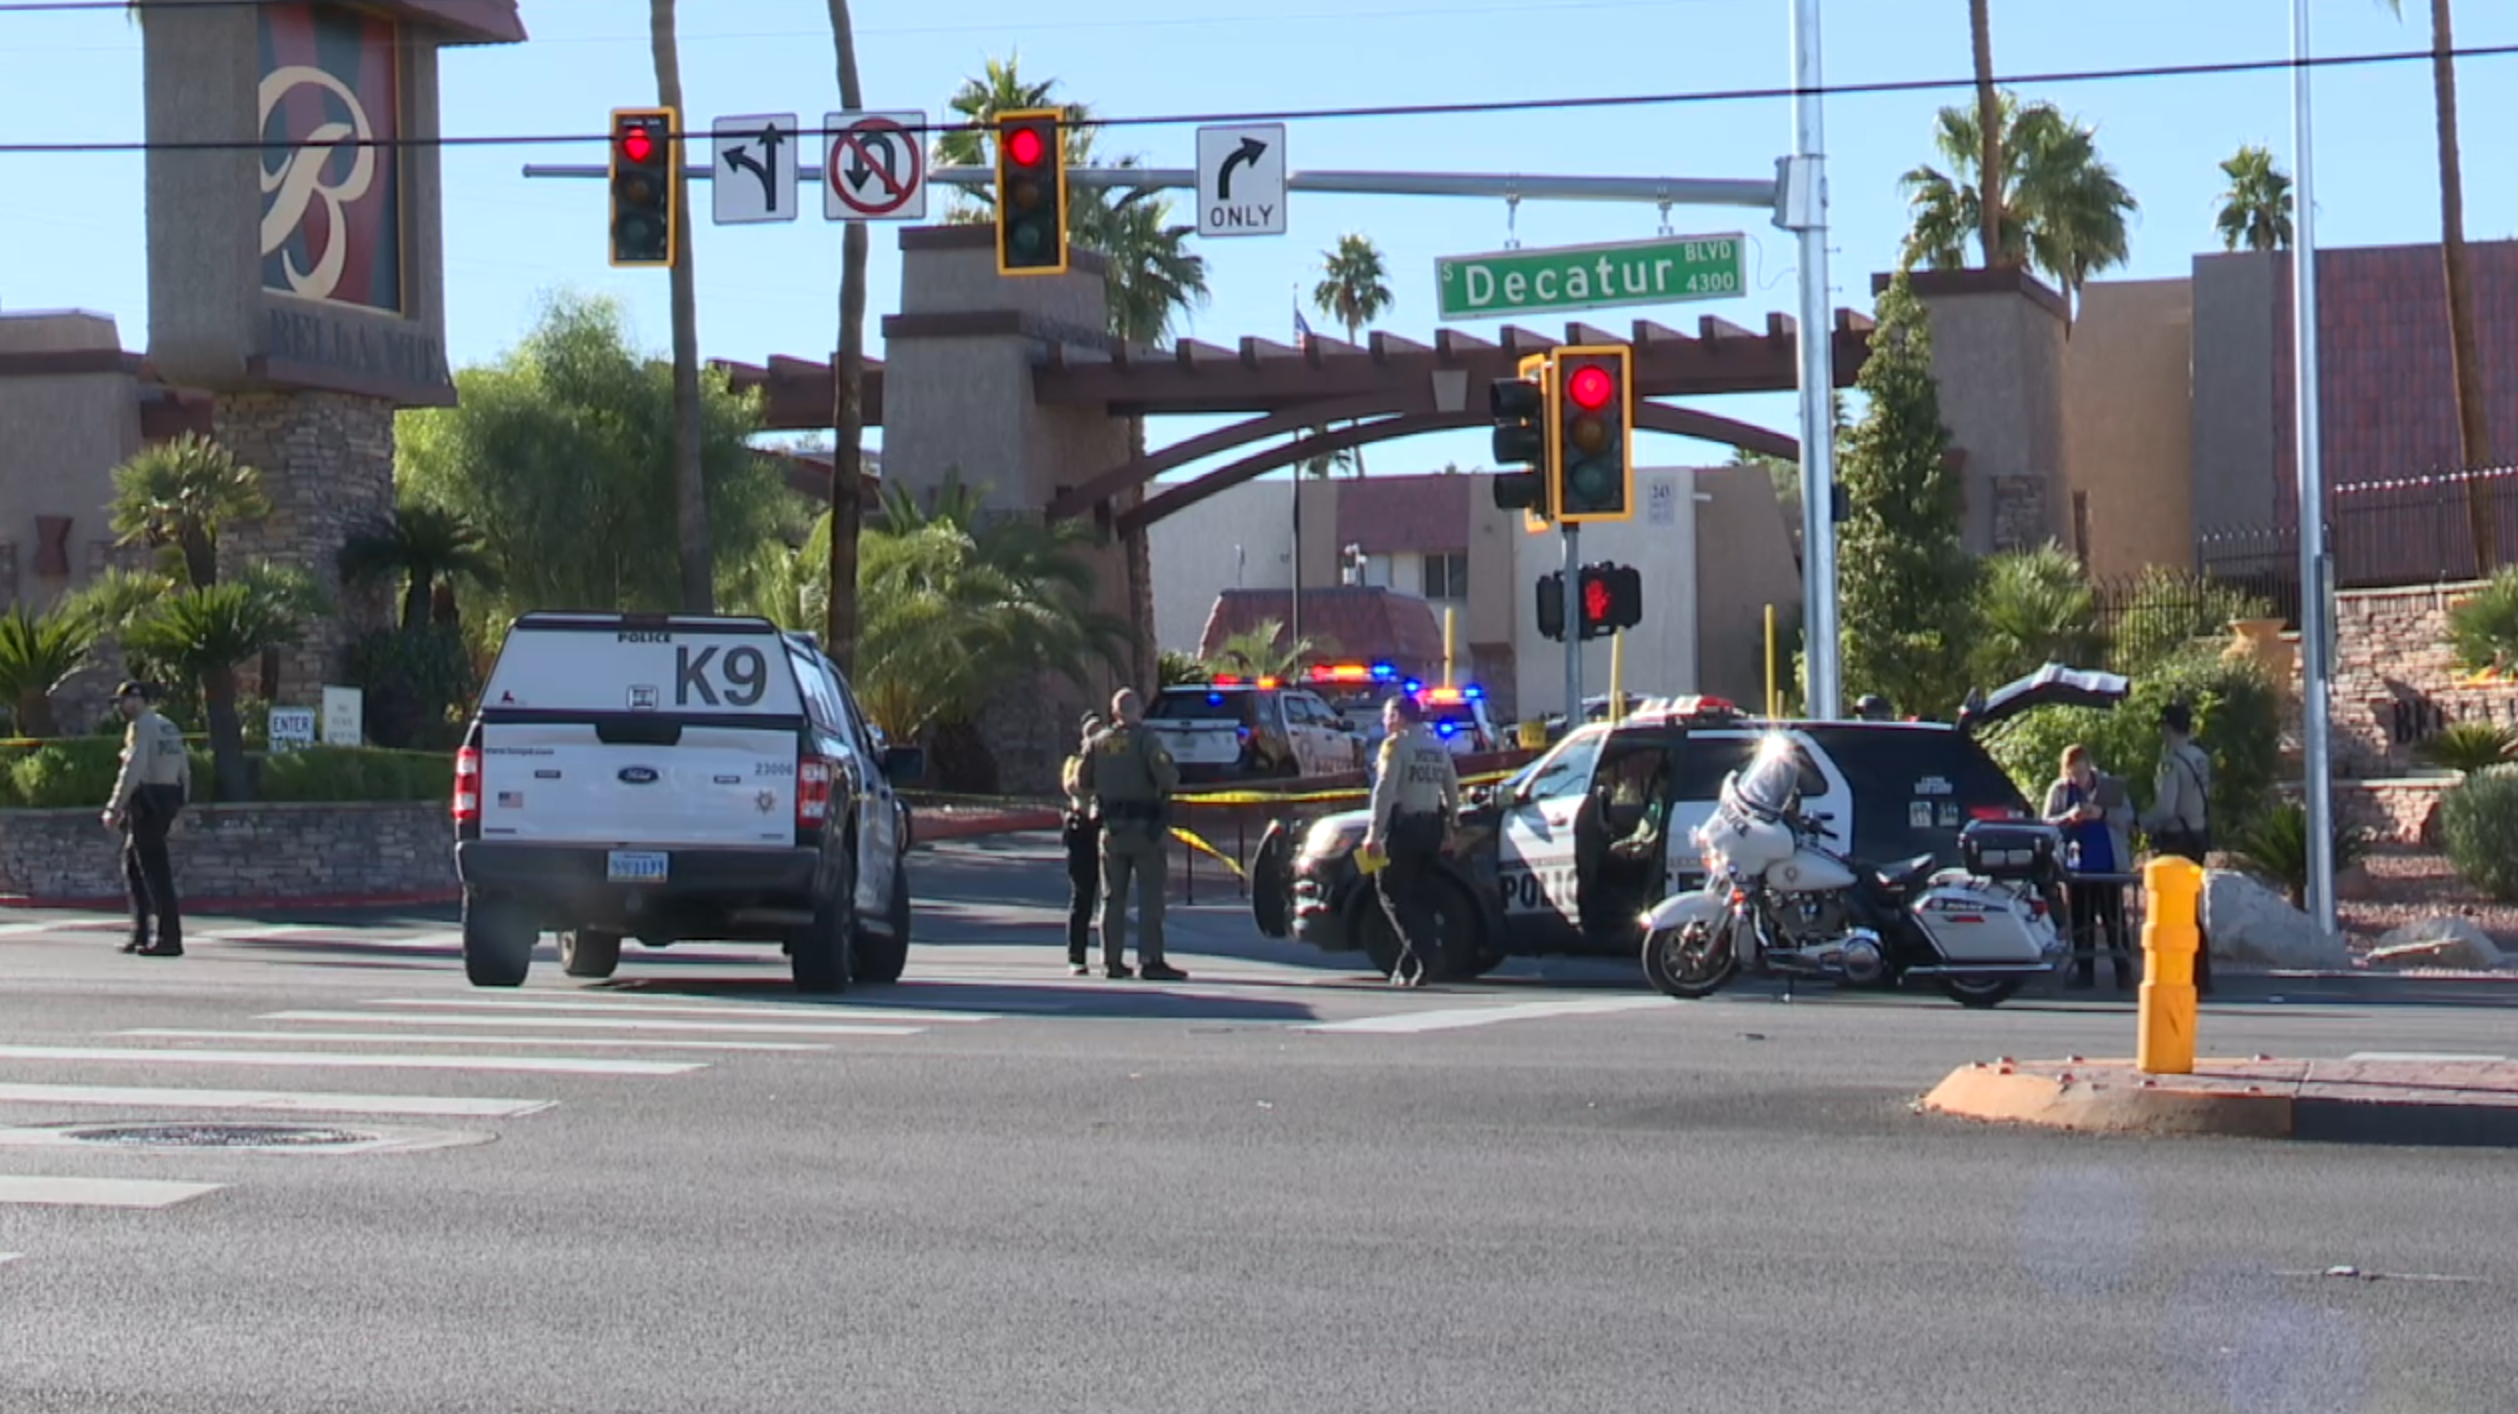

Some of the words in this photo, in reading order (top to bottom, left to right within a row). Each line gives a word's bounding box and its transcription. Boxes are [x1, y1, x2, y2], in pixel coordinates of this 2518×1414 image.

[1210, 204, 1274, 227] ONLY
[1443, 263, 1453, 281] S
[1465, 255, 1673, 306] Decatur
[1685, 241, 1731, 263] BLVD
[1686, 272, 1735, 292] 4300
[617, 633, 671, 643] POLICE
[676, 646, 767, 706] K9
[273, 716, 310, 733] ENTER
[1500, 869, 1578, 909] POLIC
